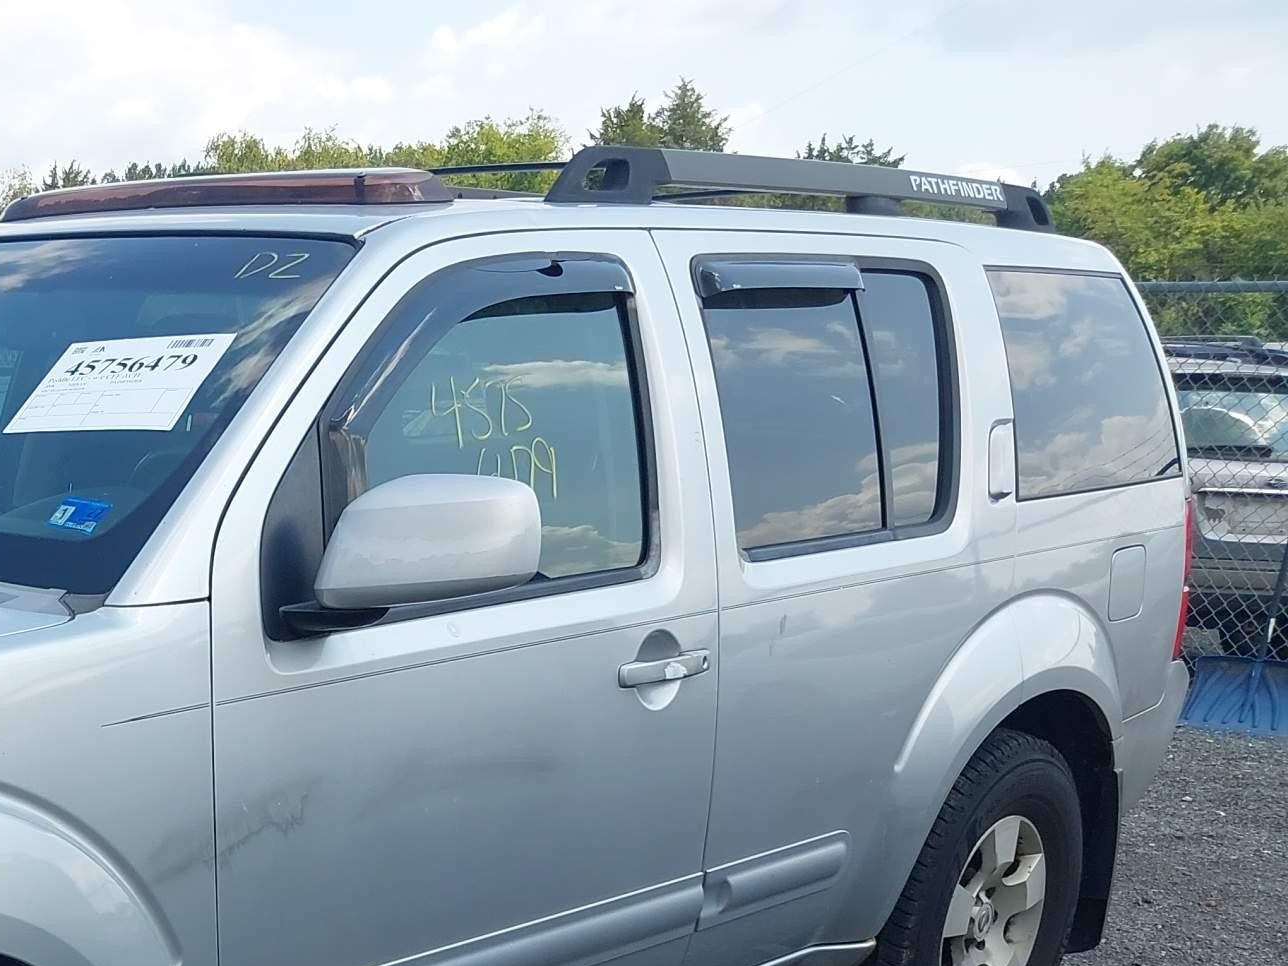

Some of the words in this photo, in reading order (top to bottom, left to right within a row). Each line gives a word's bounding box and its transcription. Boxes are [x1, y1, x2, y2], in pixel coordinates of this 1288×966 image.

[909, 175, 1004, 201] PATHFINDER
[64, 353, 198, 376] 45756479
[431, 376, 533, 449] 4575
